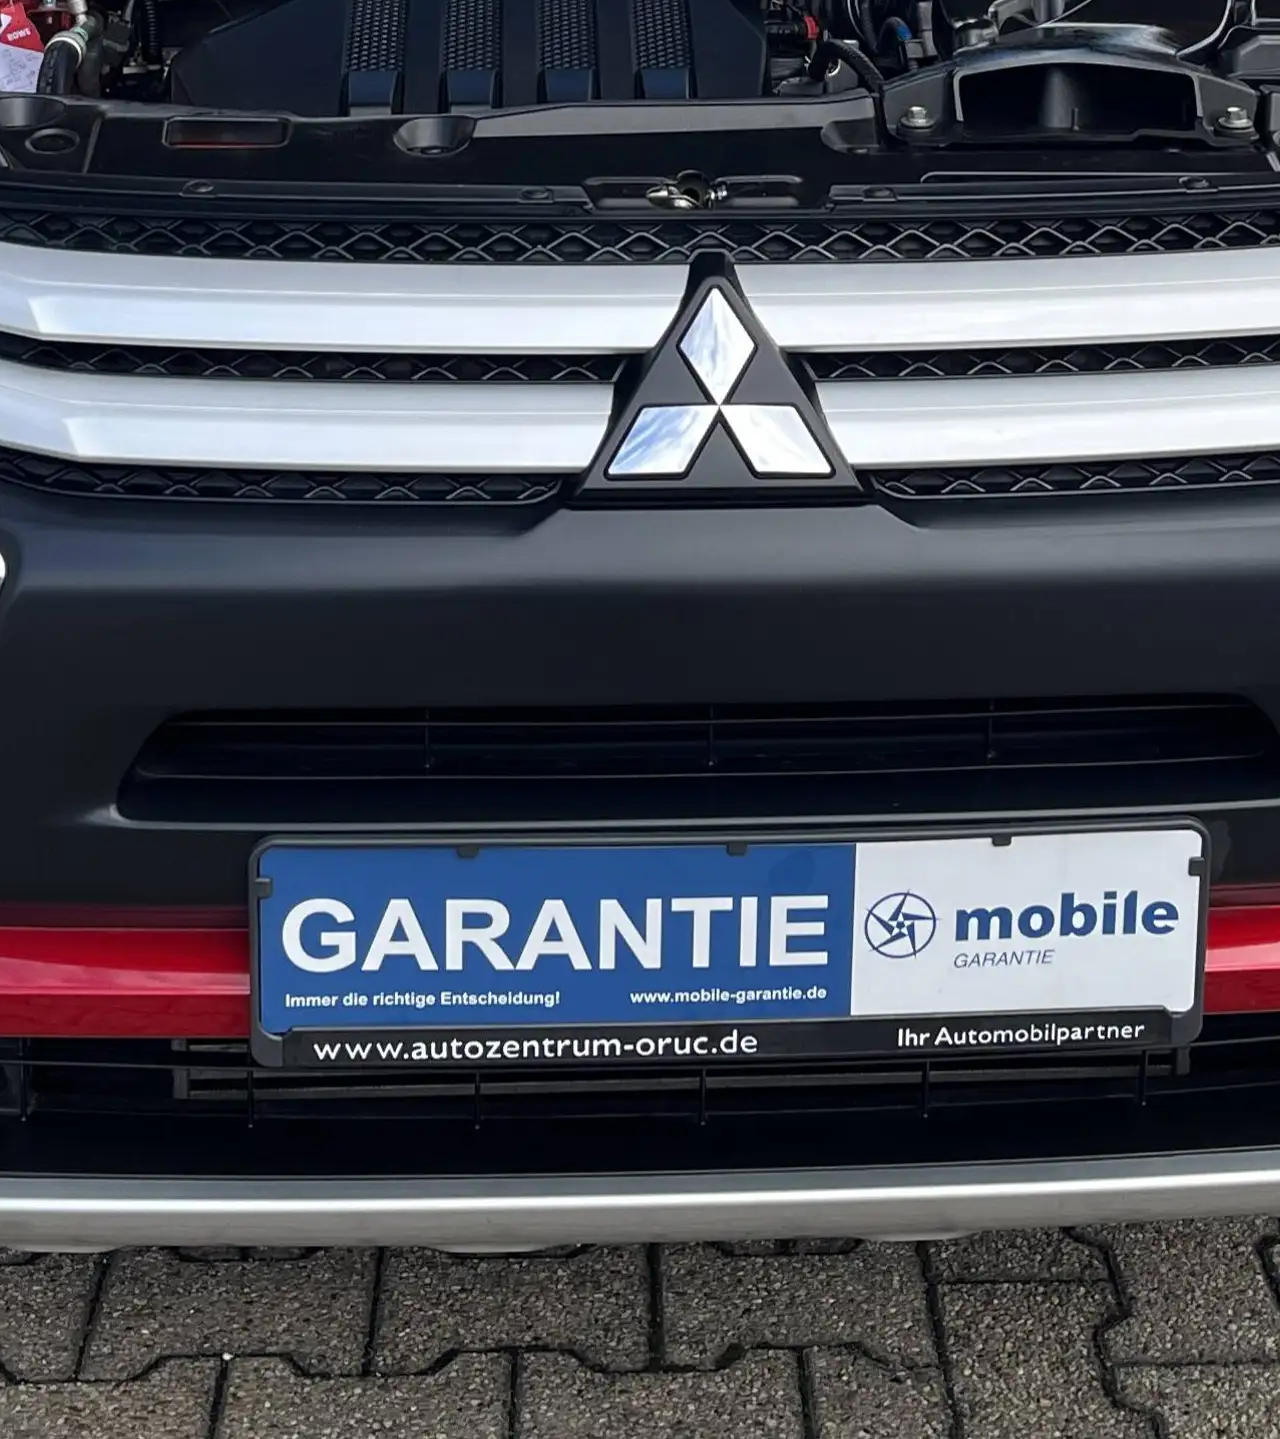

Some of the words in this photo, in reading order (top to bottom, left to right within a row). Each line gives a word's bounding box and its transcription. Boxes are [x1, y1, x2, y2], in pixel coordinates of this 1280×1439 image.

[282, 895, 829, 974] GARANTIE
[954, 890, 1180, 942] mobile
[953, 949, 1056, 969] GARANTIE
[285, 993, 338, 1008] Immer
[342, 992, 368, 1007] die
[372, 991, 436, 1010] richtige
[440, 991, 561, 1010] Entscheidung!
[630, 986, 828, 1006] www.mobile-garantie.de
[312, 1029, 759, 1062] www.autozentrum-oruc.de
[898, 1027, 930, 1047] Ihr
[934, 1022, 1145, 1047] Automobilpartner
